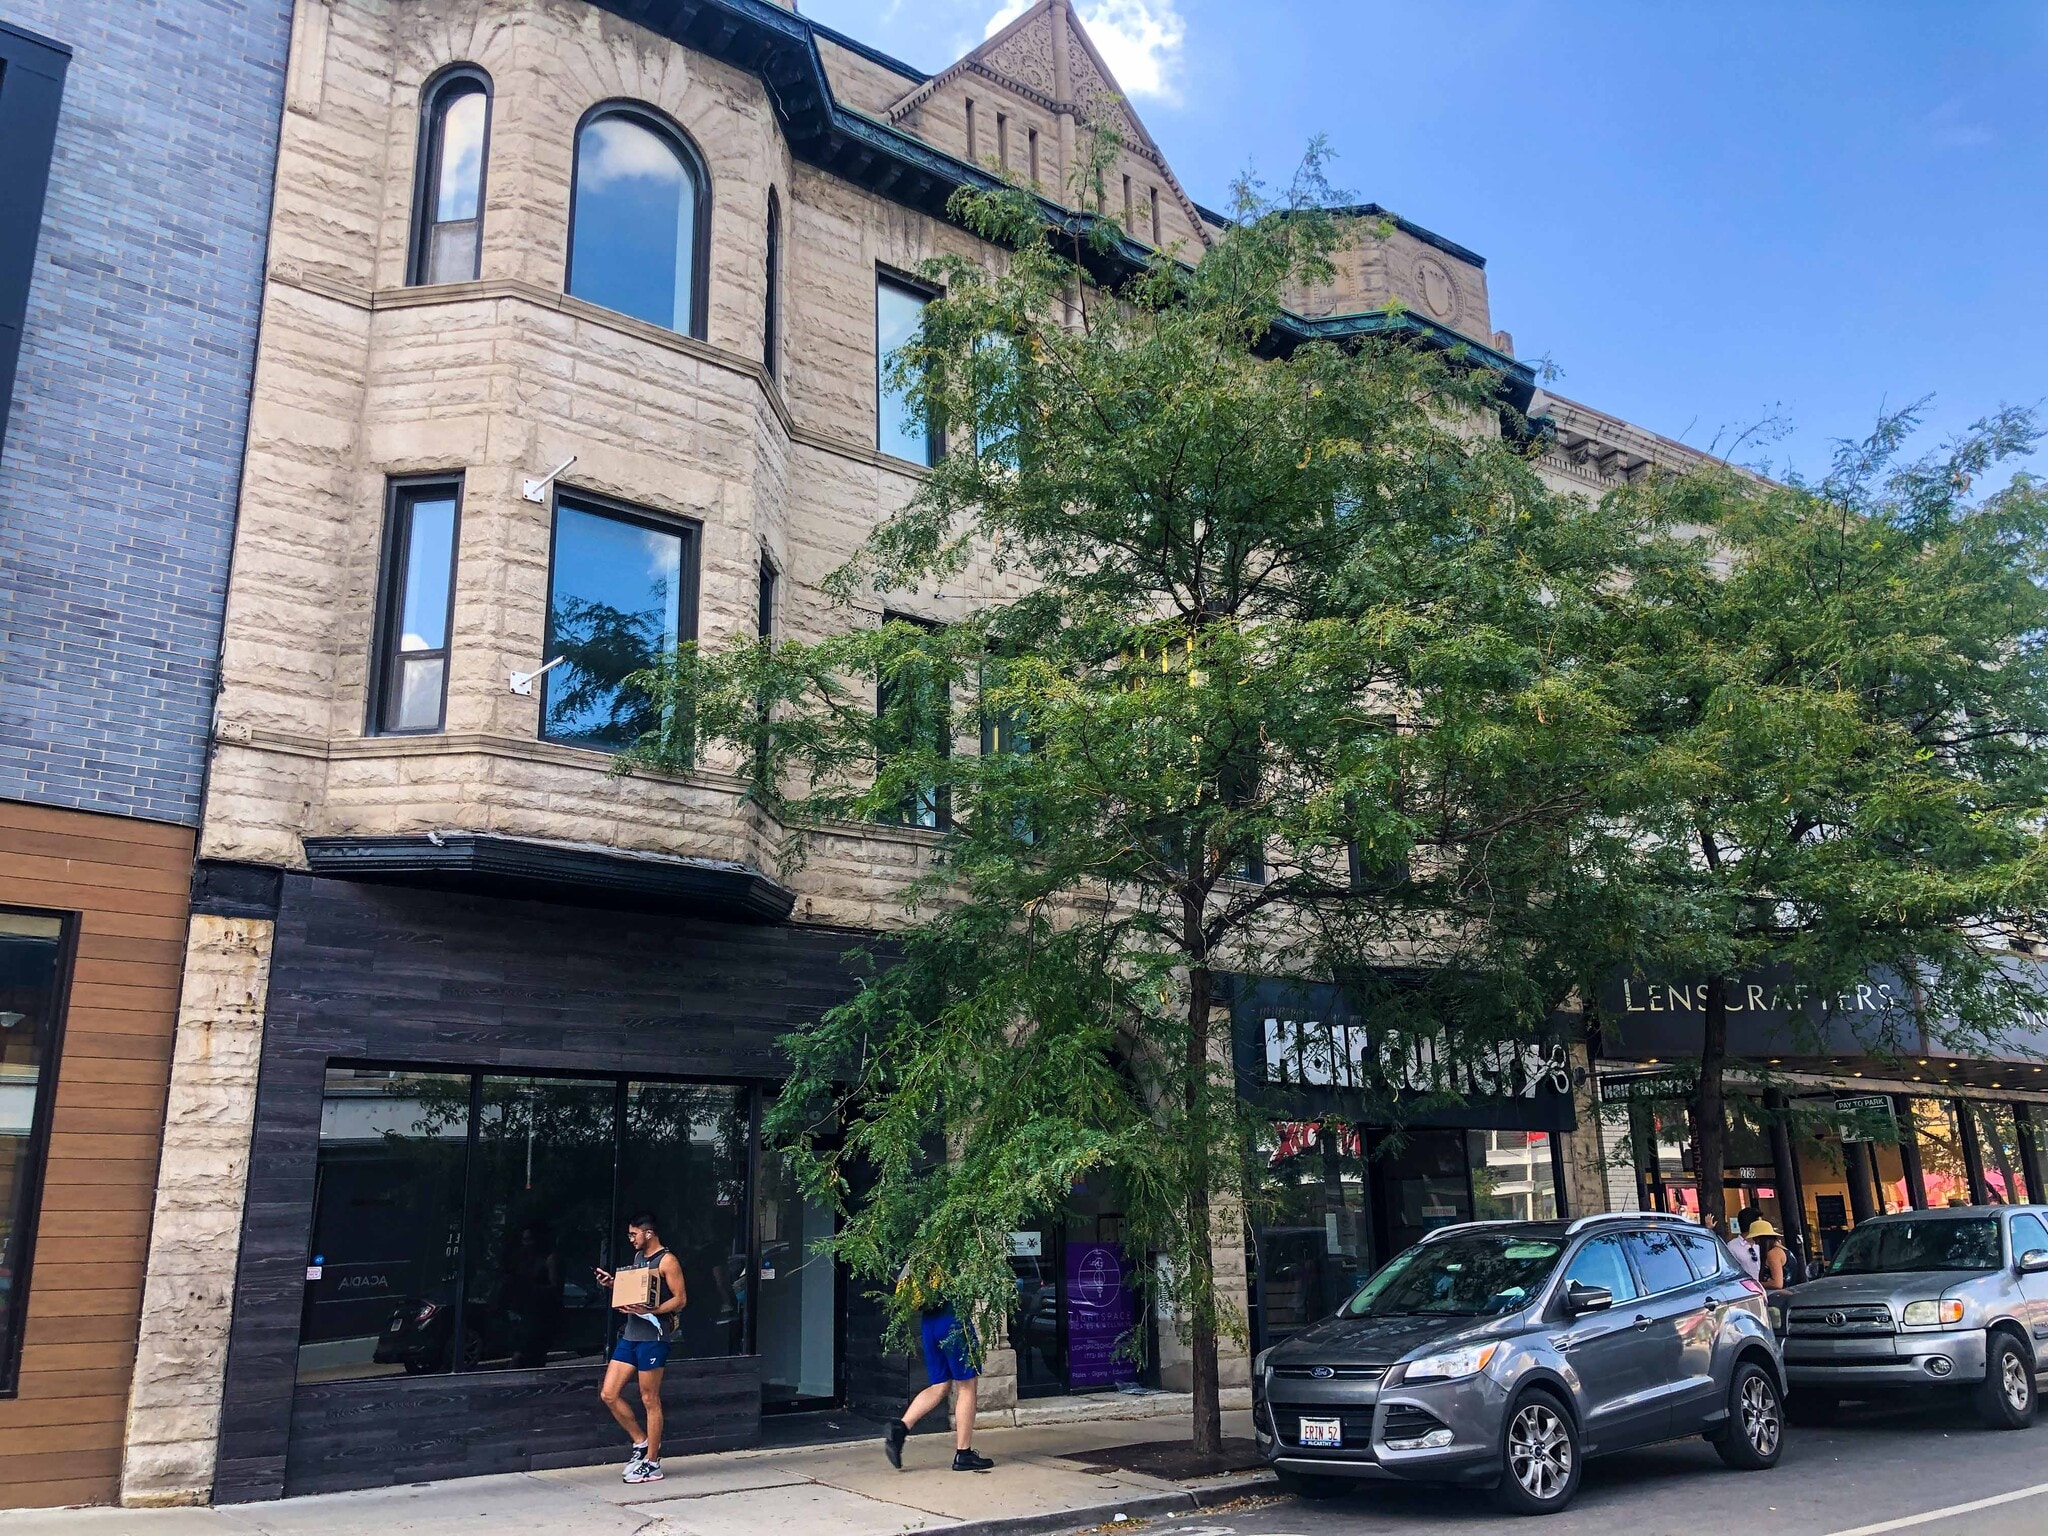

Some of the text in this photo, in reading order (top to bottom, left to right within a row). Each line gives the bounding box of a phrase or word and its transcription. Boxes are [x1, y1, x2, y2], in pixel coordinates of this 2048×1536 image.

[1623, 978, 1895, 1012] LENSRAFERS
[1864, 1098, 1884, 1107] PARK
[1304, 1425, 1338, 1441] ERIN 52
